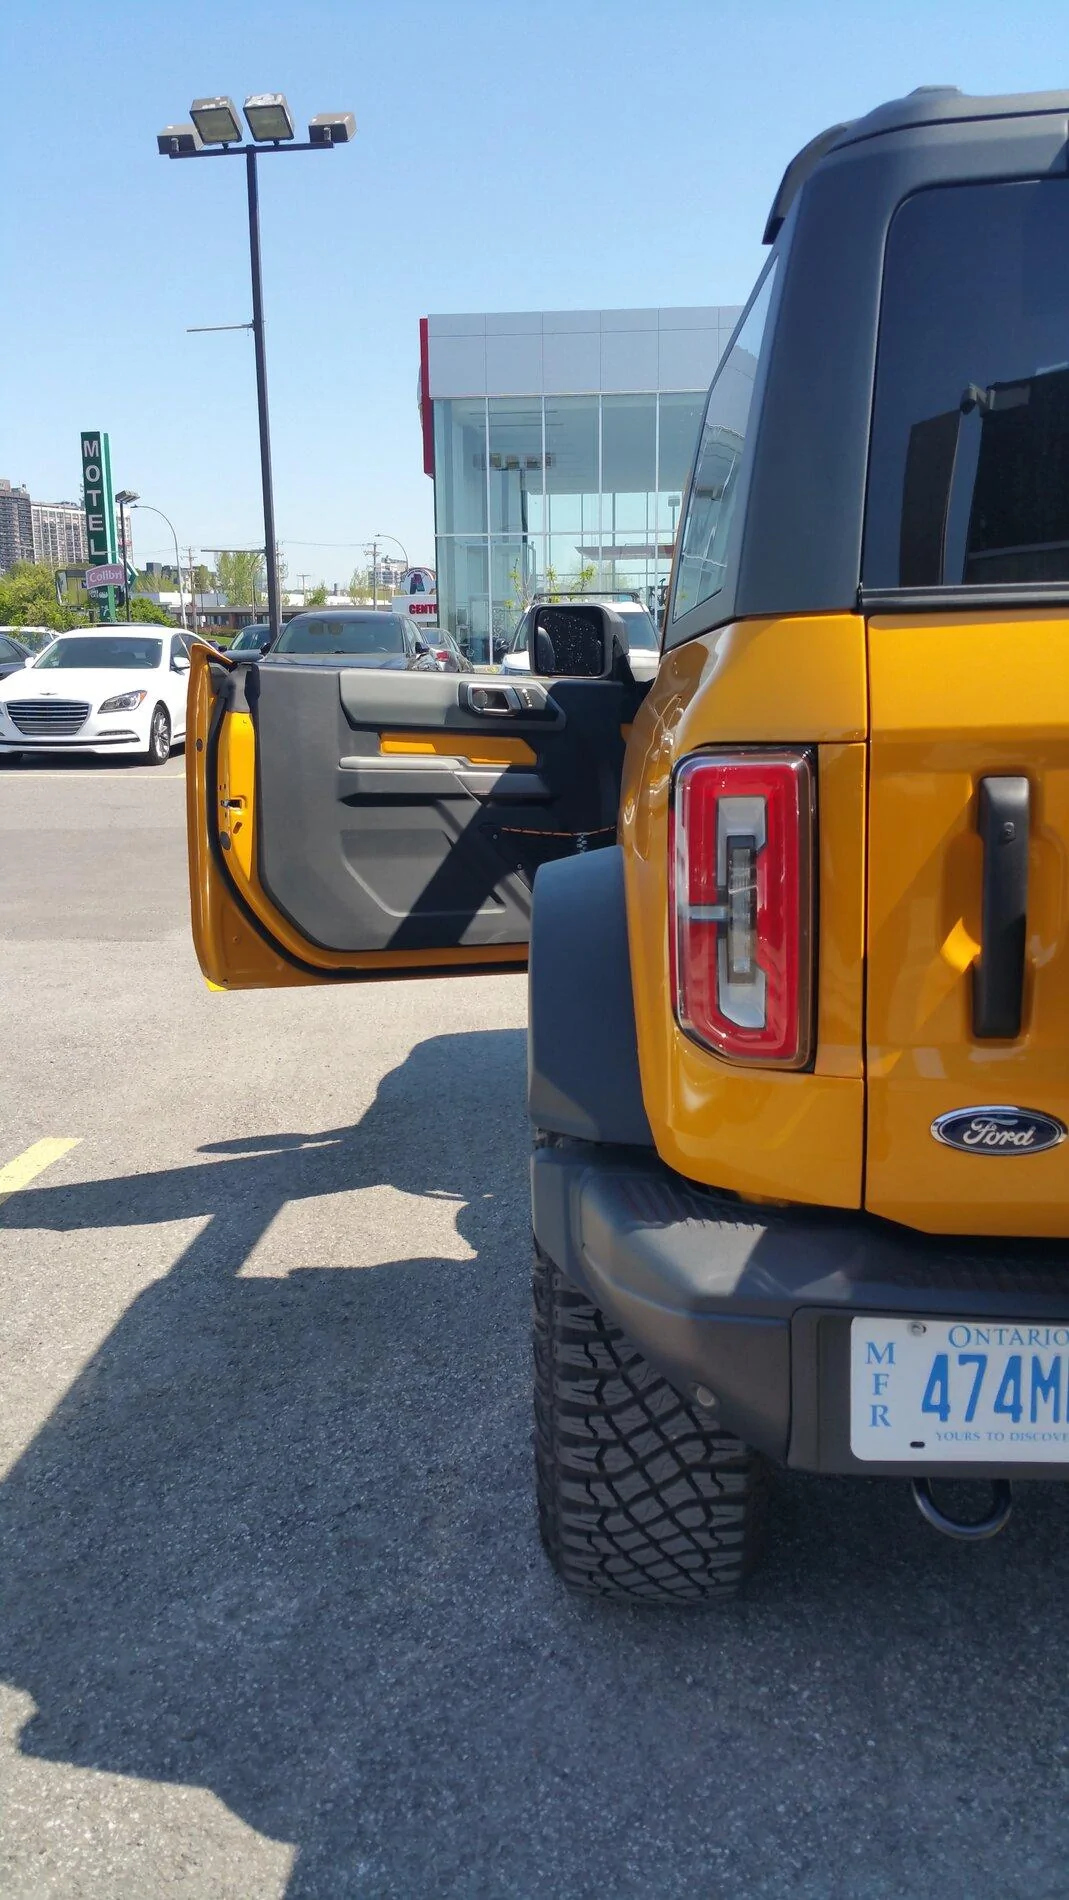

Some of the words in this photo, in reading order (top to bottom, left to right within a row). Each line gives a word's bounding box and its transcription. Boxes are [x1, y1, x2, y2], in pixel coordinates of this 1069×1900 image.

[83, 440, 107, 556] MOTEL
[89, 569, 123, 583] Colibri
[962, 1116, 1037, 1146] Ford
[947, 1324, 1069, 1349] ONTARIO
[864, 1341, 897, 1428] MFR
[921, 1352, 1069, 1424] 474M
[935, 1431, 981, 1441] YOURS
[987, 1431, 1005, 1441] TO
